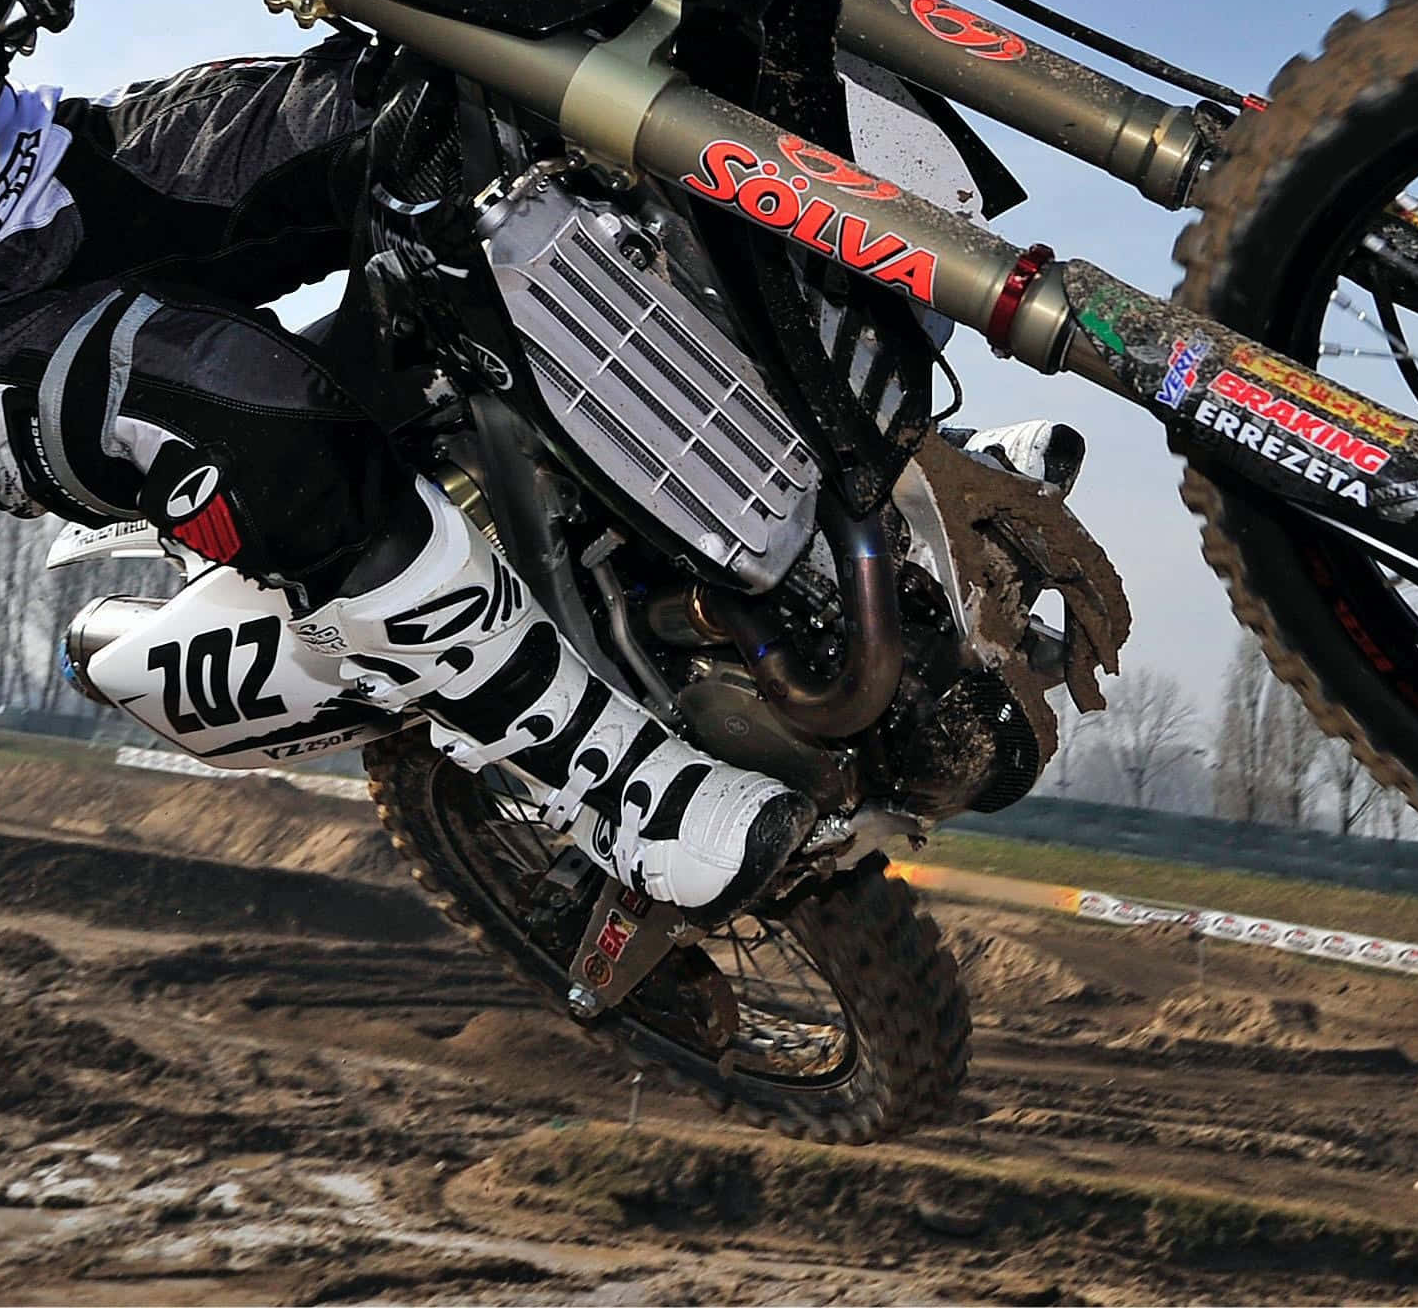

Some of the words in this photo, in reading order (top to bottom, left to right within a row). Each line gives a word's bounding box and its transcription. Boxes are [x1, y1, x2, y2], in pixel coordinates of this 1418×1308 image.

[681, 139, 938, 306] SÖLVA
[1195, 400, 1369, 508] ERREZETA
[1208, 368, 1391, 475] BRAKING
[147, 615, 288, 735] 202
[262, 725, 366, 760] YZ250F
